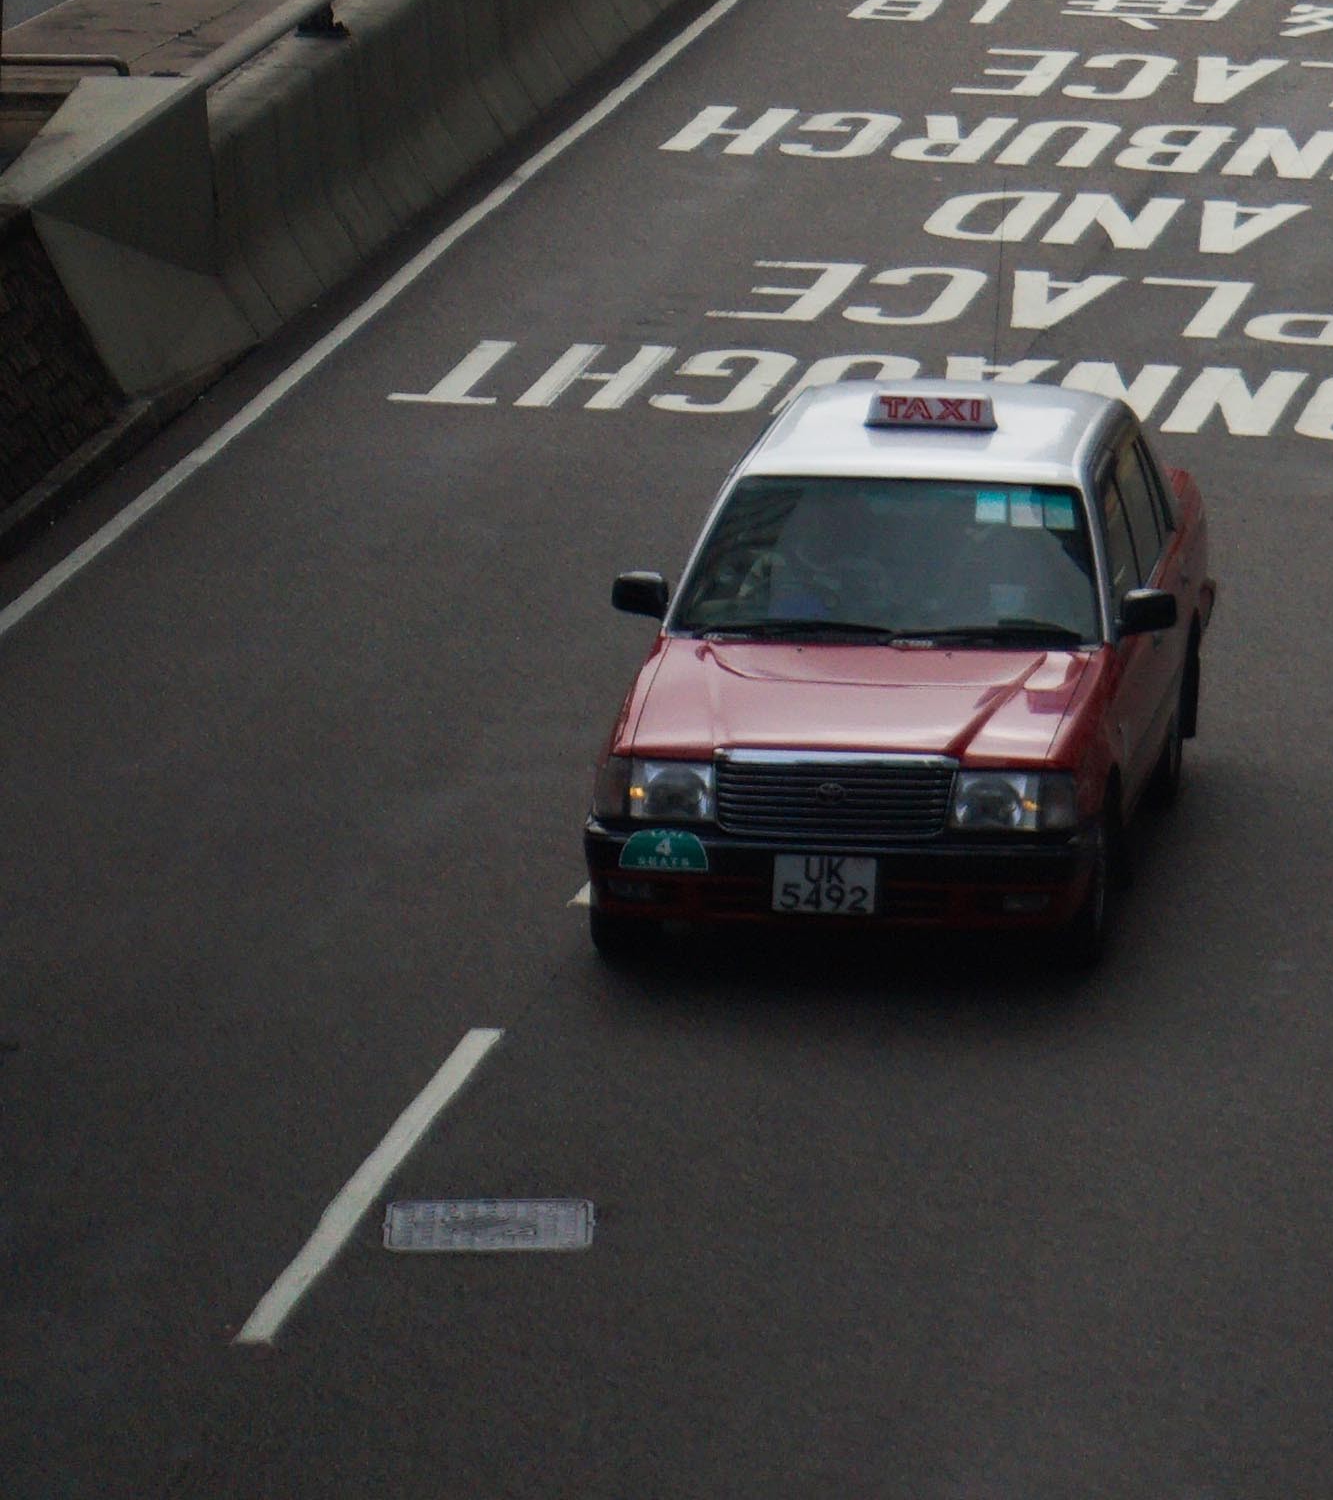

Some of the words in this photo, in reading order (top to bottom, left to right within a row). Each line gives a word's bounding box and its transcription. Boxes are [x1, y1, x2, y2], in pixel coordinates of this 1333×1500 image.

[922, 190, 1312, 255] AND
[879, 395, 983, 422] TAXI
[655, 837, 672, 857] 4
[803, 858, 845, 885] UK
[778, 886, 870, 913] 5492
